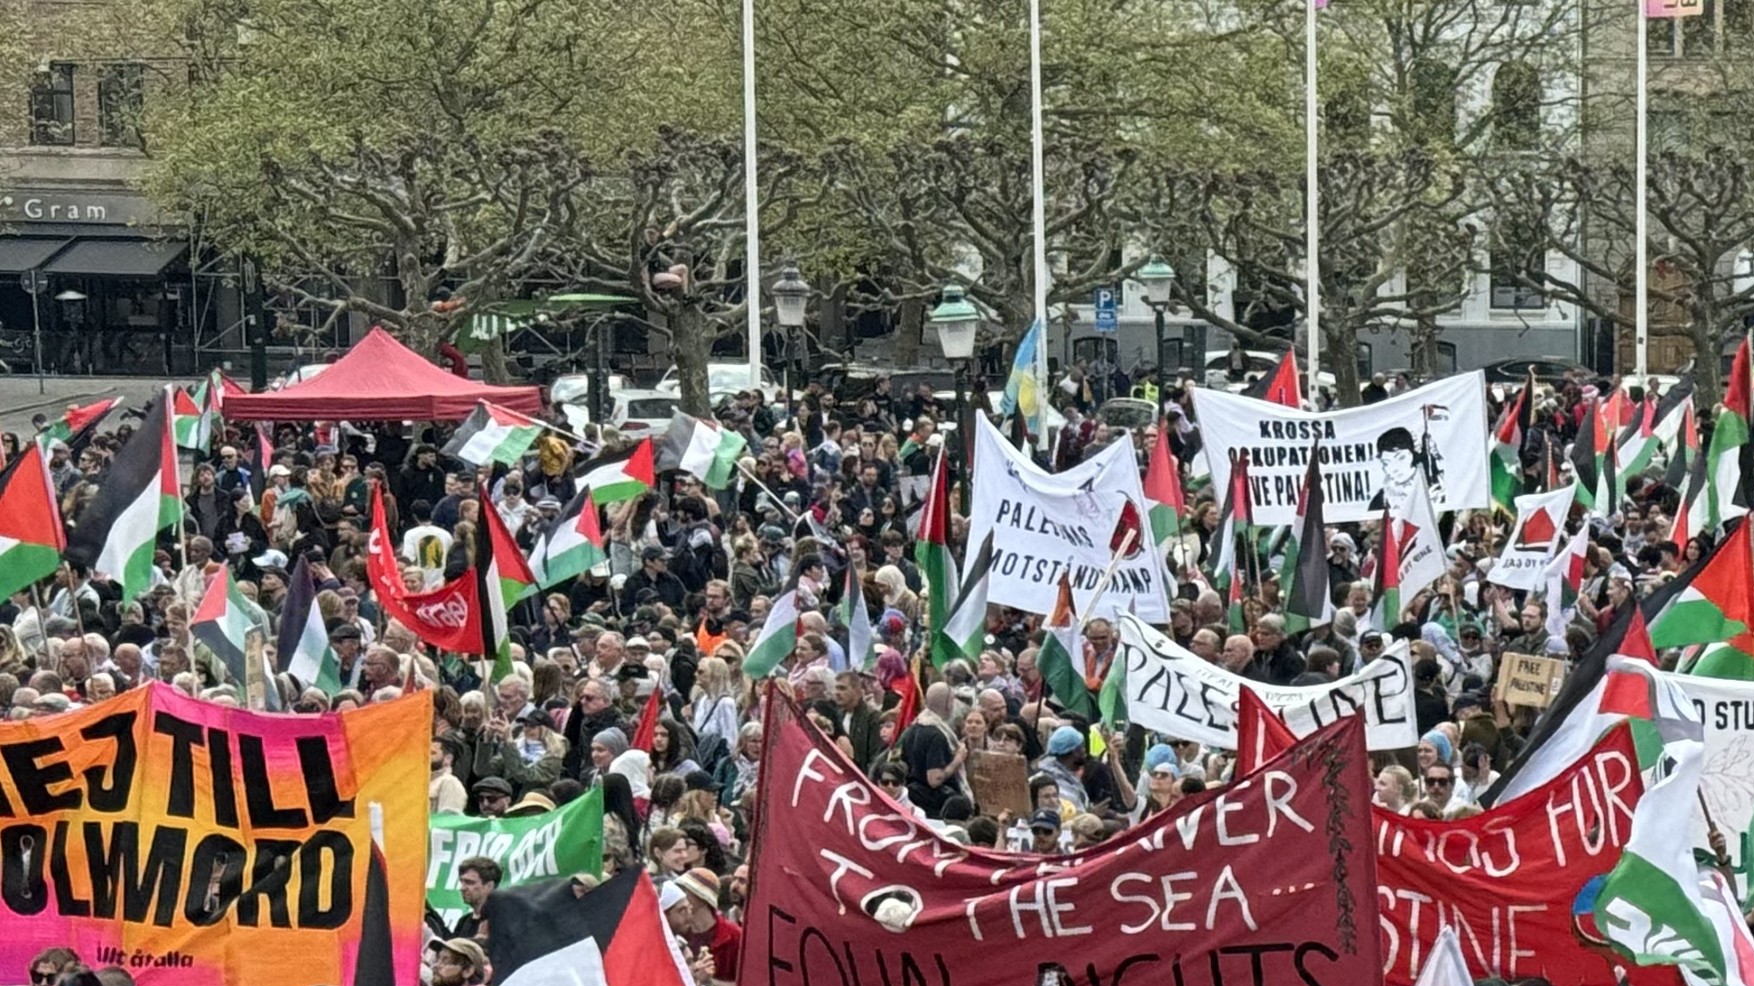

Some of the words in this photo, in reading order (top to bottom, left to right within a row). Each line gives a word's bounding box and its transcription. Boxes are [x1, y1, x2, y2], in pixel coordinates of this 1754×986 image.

[24, 199, 106, 220] Gram
[1259, 420, 1336, 440] KROSSA
[1228, 442, 1374, 467] OCKUPATONEN!
[154, 710, 357, 829] TILL
[820, 849, 924, 934] TO
[965, 879, 1093, 940] THE
